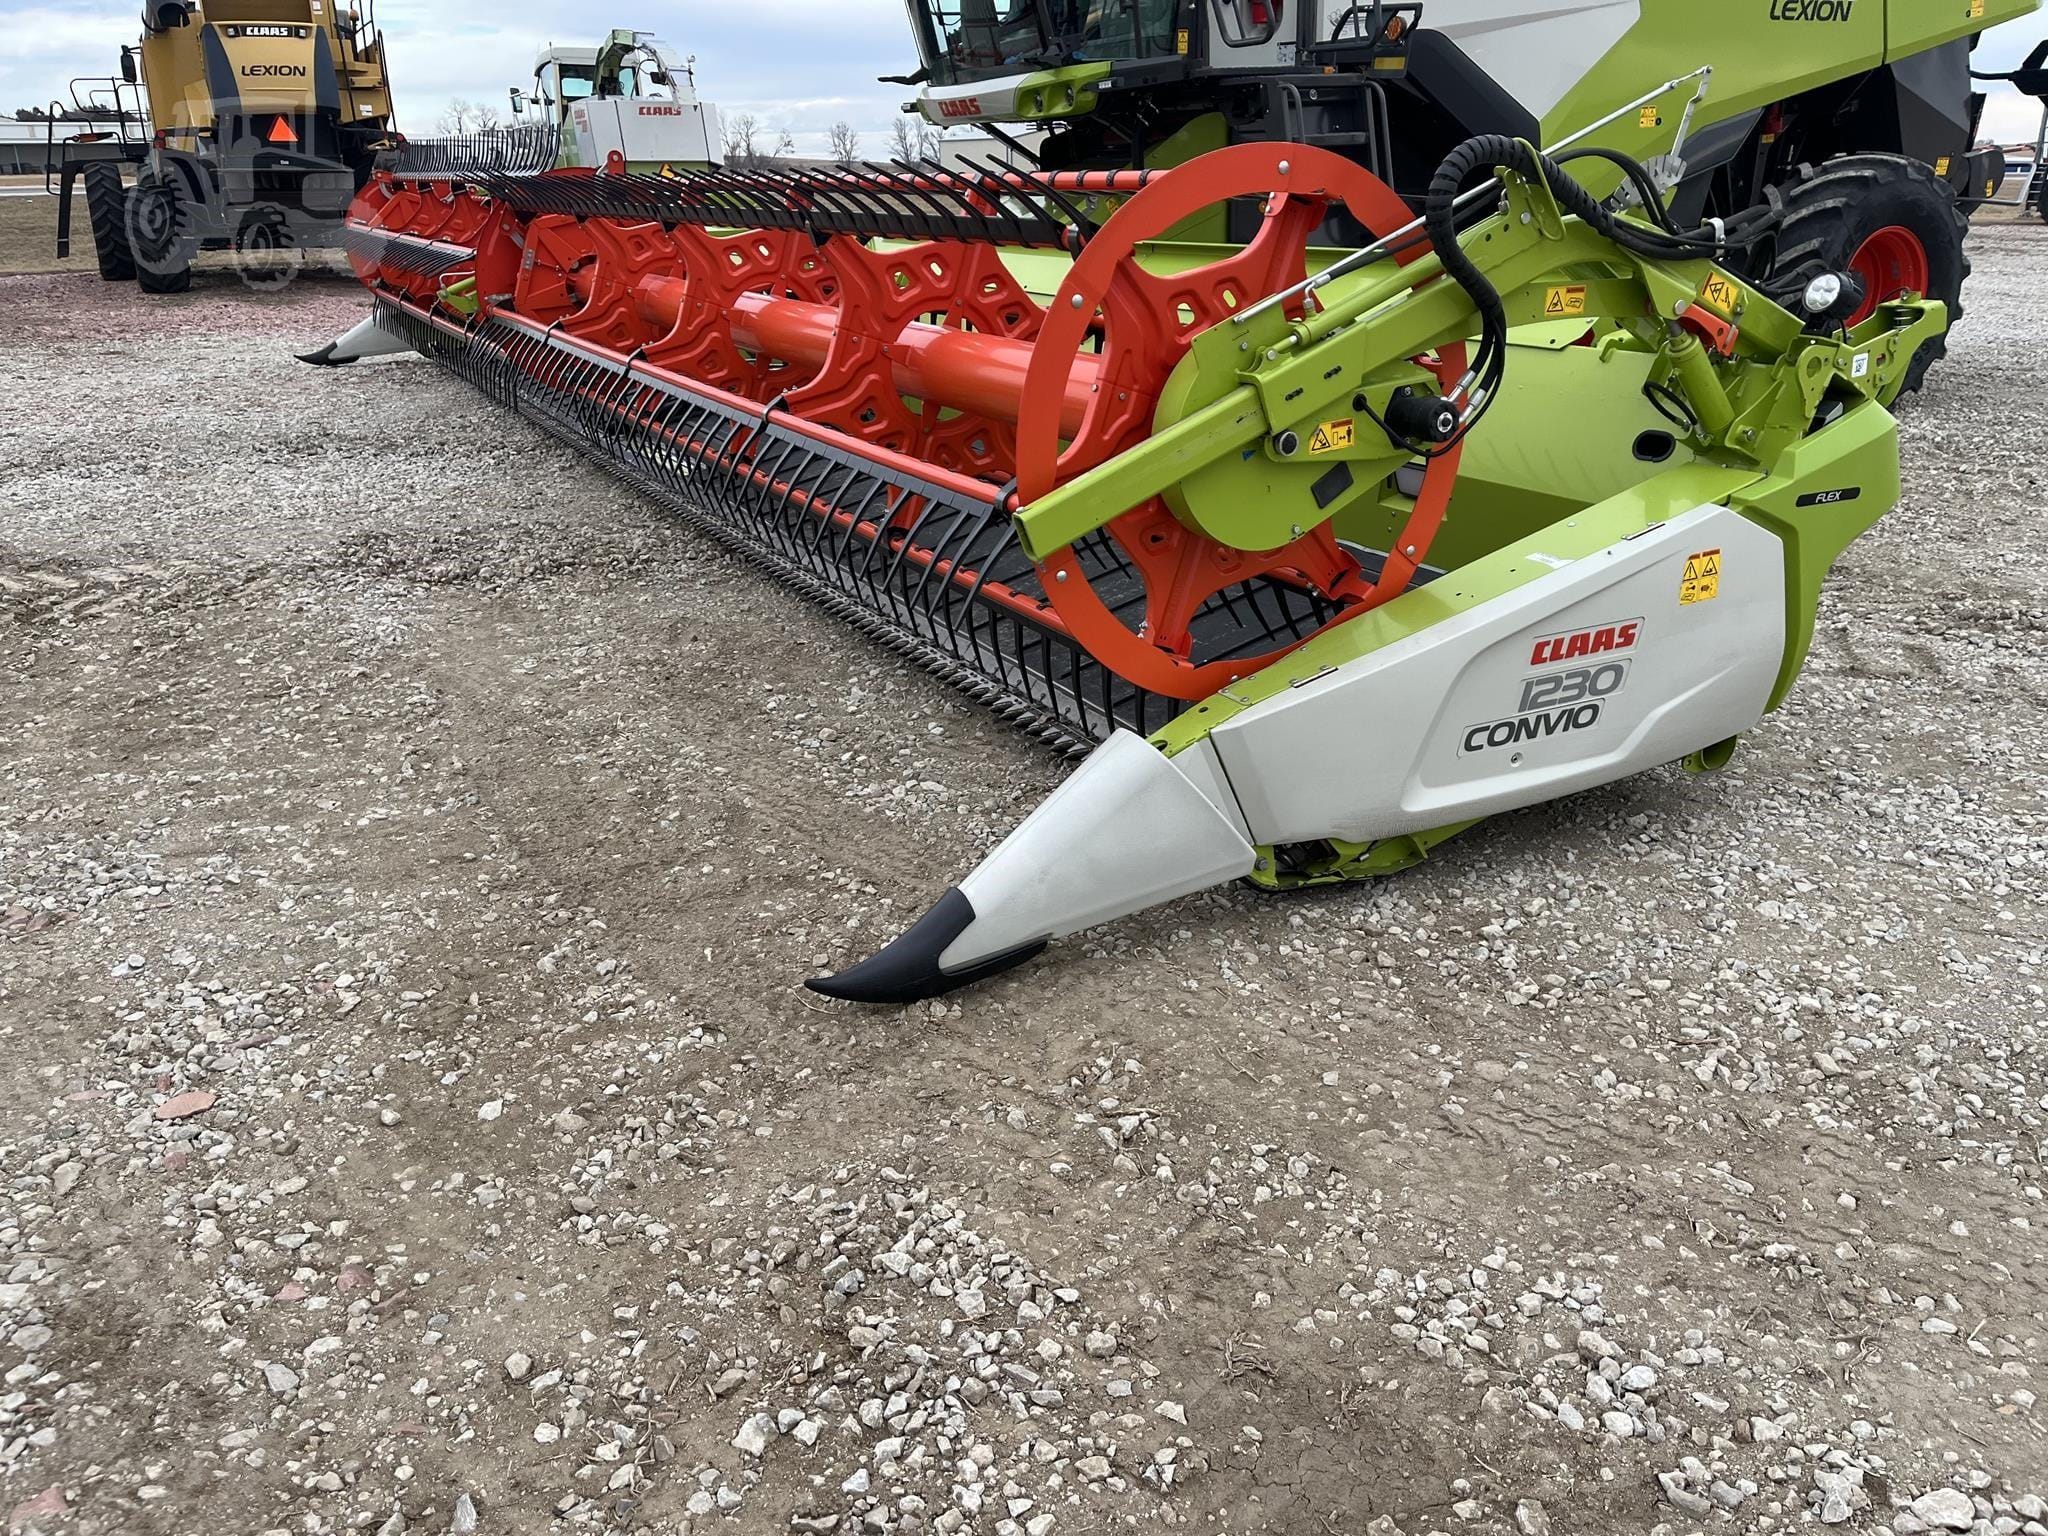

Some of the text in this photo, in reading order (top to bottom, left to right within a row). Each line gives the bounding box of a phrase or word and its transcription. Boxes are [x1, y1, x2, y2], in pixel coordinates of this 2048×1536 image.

[1769, 0, 1852, 21] LEXION
[245, 26, 289, 36] CLAAS
[241, 64, 306, 77] LEXION
[938, 98, 981, 117] CLAAS
[1815, 490, 1842, 503] FLEX
[1529, 622, 1639, 666] CLAAS
[1517, 663, 1625, 713] 1230
[1463, 703, 1601, 753] CONVIO
